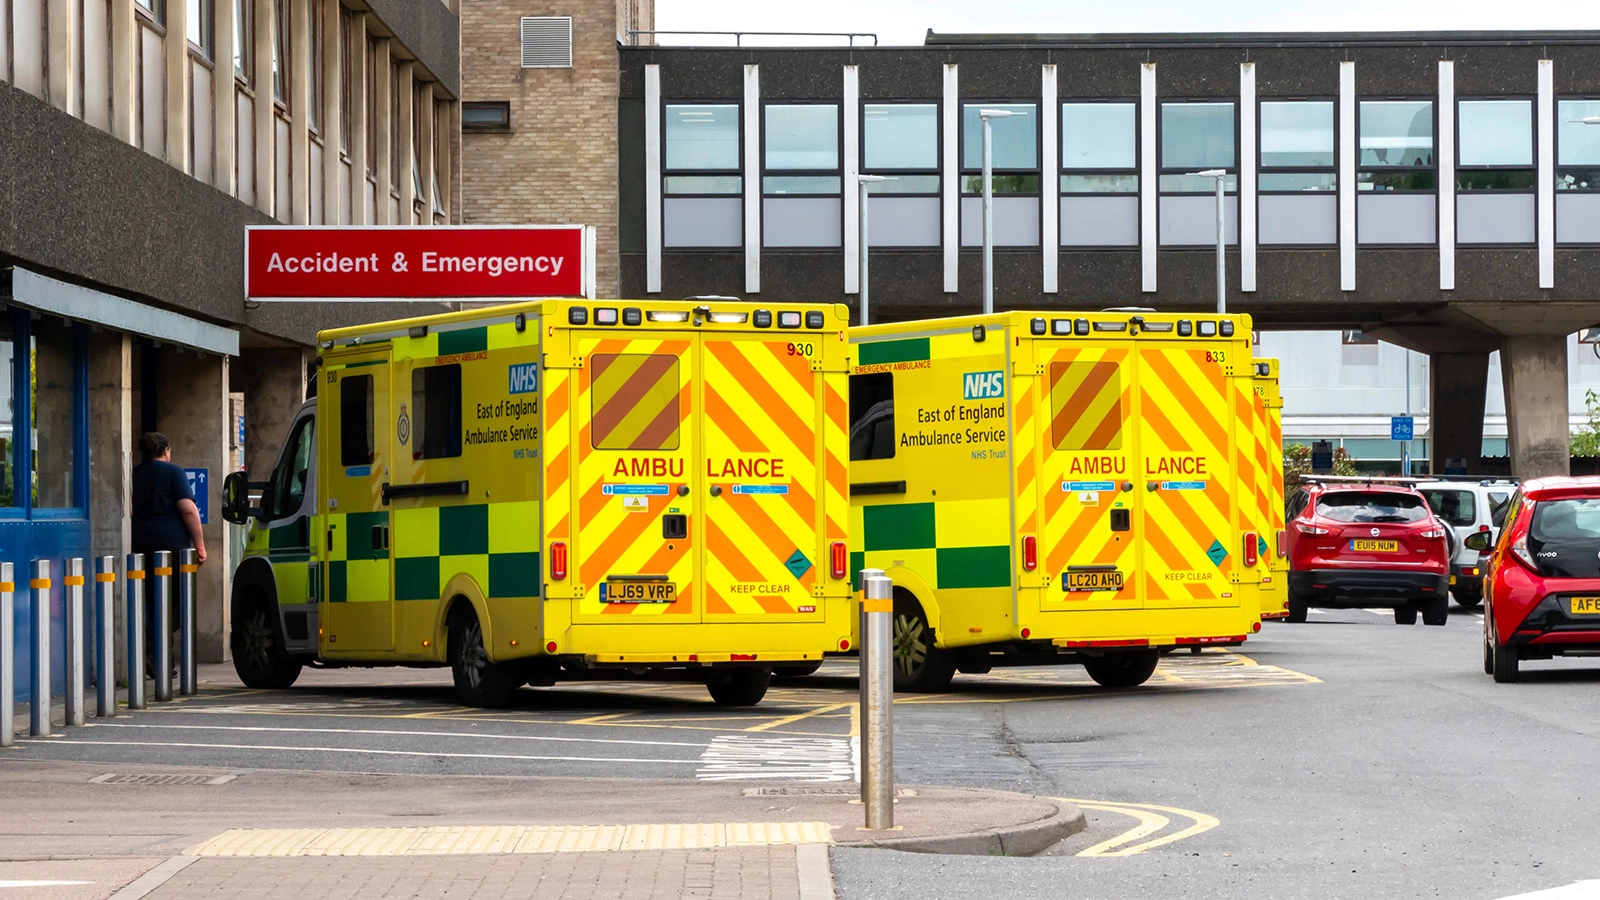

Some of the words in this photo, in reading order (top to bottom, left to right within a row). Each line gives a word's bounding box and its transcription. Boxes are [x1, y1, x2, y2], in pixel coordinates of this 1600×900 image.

[267, 251, 379, 273] Accident
[391, 251, 409, 273] &
[422, 251, 564, 277] Emergency
[787, 342, 813, 356] 930
[1205, 351, 1225, 362] 833
[435, 354, 461, 366] EMERGENCY
[461, 350, 488, 362] AMBULANCE
[855, 364, 892, 374] EMERGENCY
[893, 360, 931, 371] AMBULANCE
[326, 371, 337, 383] 930
[509, 365, 537, 392] NHS
[964, 372, 1003, 399] NHS
[477, 402, 493, 420] East
[495, 401, 504, 418] of
[506, 397, 538, 420] England
[918, 408, 941, 424] East
[943, 405, 956, 421] of
[959, 402, 1005, 424] England
[464, 427, 508, 445] Ambulance
[510, 424, 538, 442] Service
[900, 430, 962, 447] Ambulance
[966, 426, 1006, 443] Service
[513, 449, 525, 459] NHS
[526, 448, 538, 458] Trust
[971, 450, 987, 460] NHS
[989, 449, 1007, 459] Trust
[613, 457, 684, 477] AMBU
[707, 458, 784, 477] LANCE
[1070, 456, 1126, 474] AMBU
[1146, 456, 1207, 474] LANCE
[1357, 541, 1376, 550] EU15
[1378, 541, 1395, 550] NUM
[1070, 573, 1098, 587] LC20
[1101, 573, 1122, 586] AHO
[1165, 573, 1185, 581] KEEP
[1187, 572, 1212, 581] CLEAR
[608, 584, 644, 599] LJ69
[649, 584, 674, 599] VRP
[730, 585, 756, 593] KEEP
[758, 584, 791, 593] CLEAR
